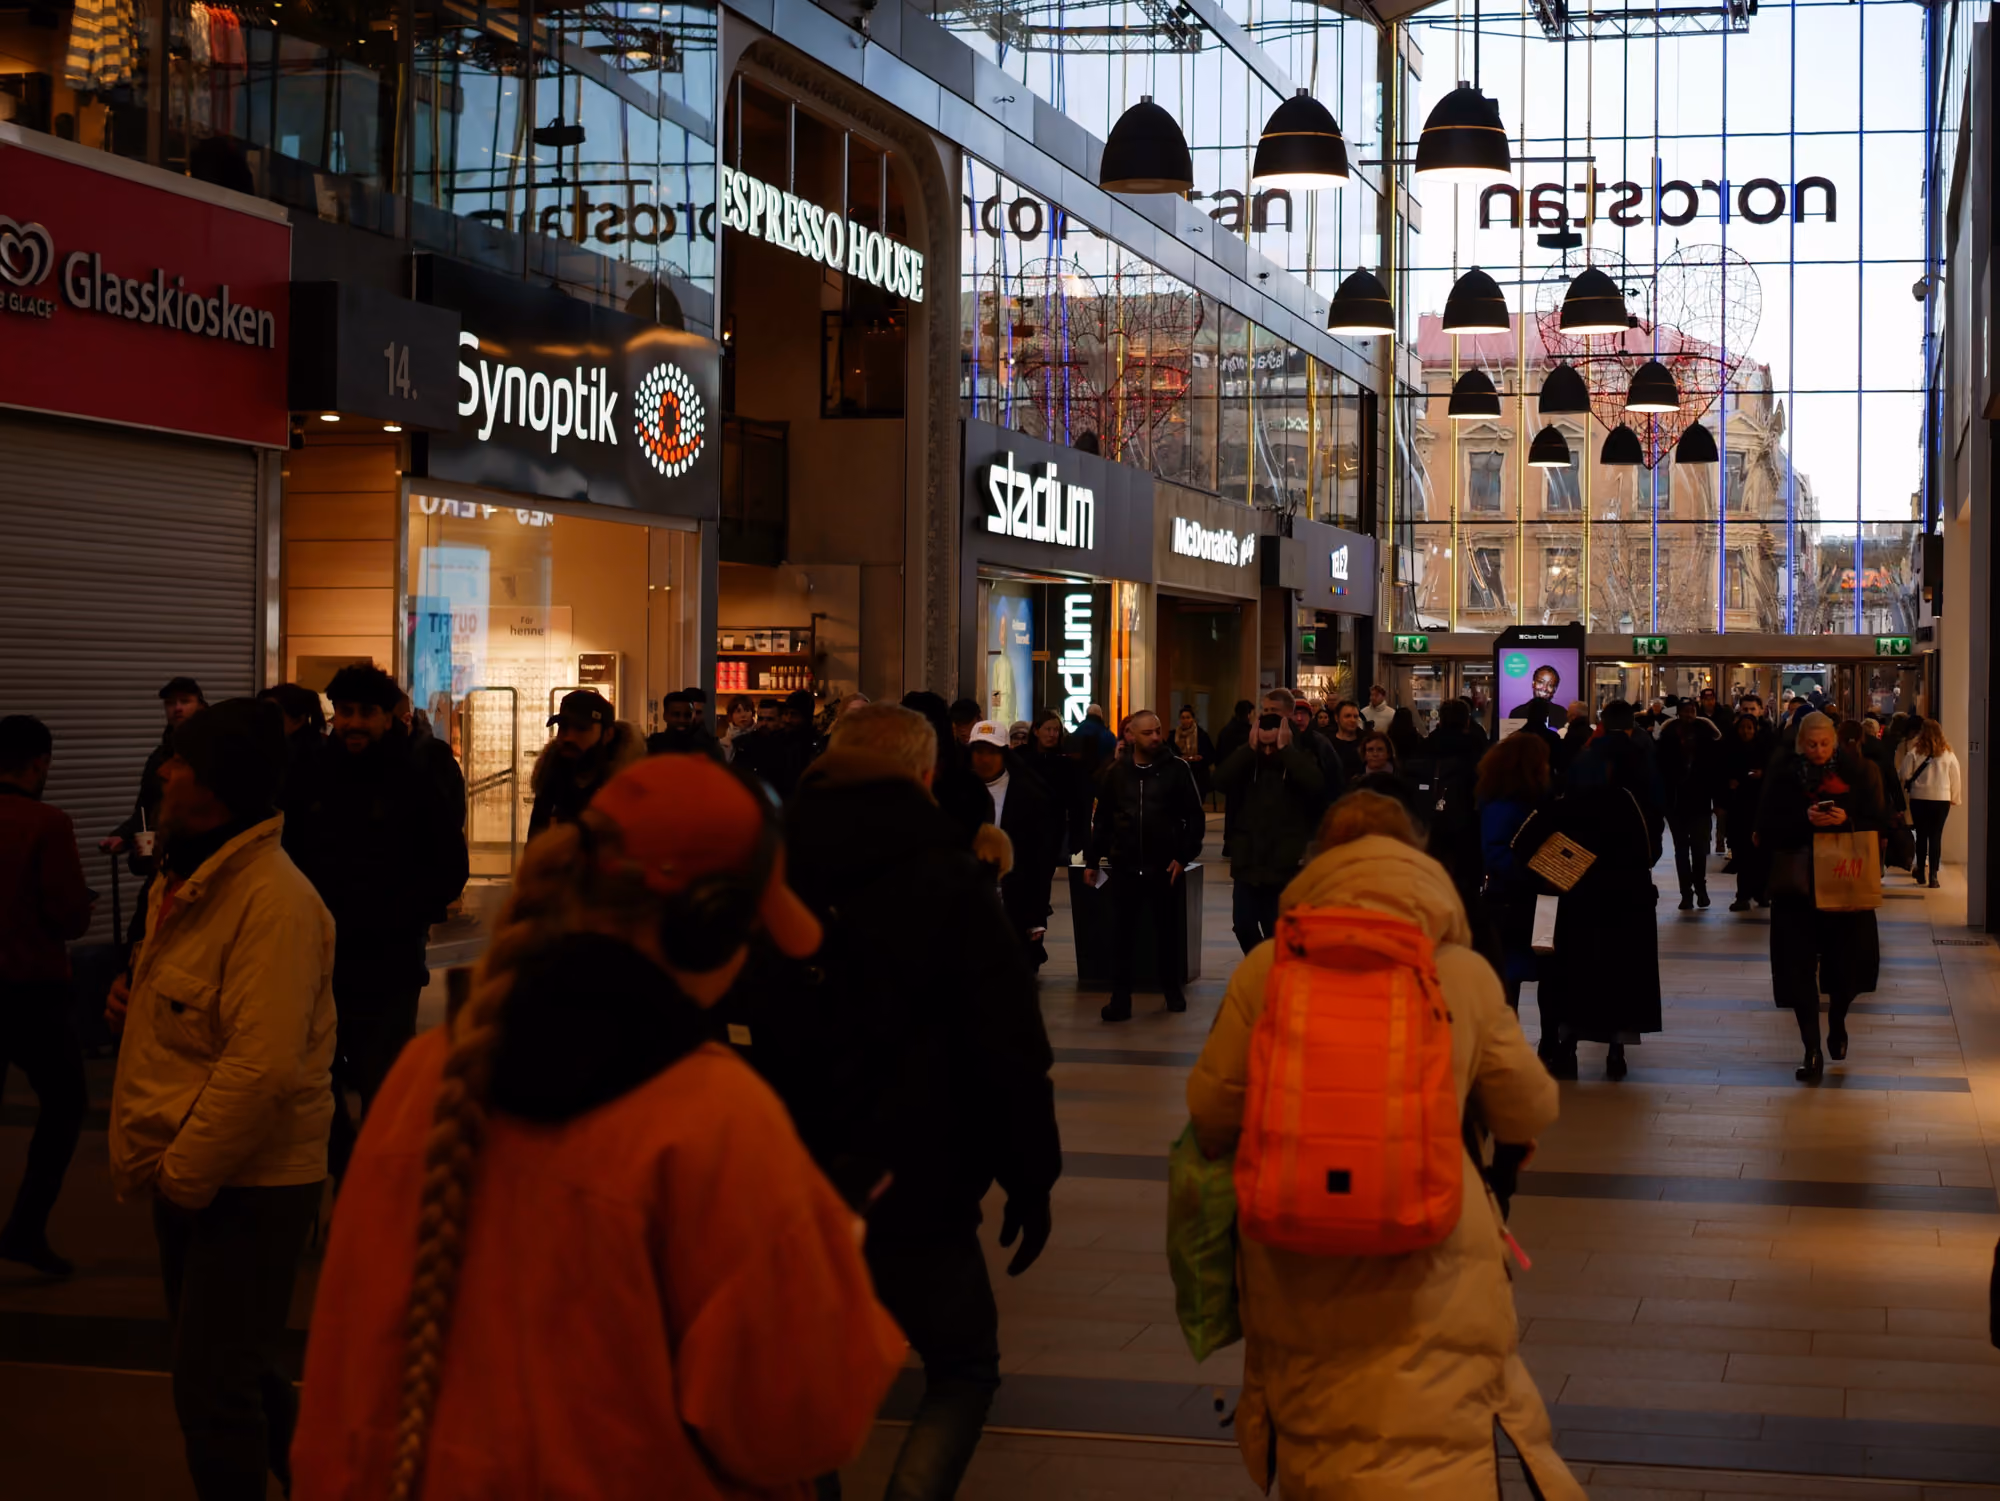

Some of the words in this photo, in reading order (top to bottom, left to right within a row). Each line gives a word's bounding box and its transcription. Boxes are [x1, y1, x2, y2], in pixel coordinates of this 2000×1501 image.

[721, 164, 845, 272] ESPRESSO
[848, 219, 925, 304] HOUSE
[9, 291, 53, 320] GLACE
[64, 250, 276, 349] Glasskiosken
[458, 330, 619, 455] Synoptik
[987, 450, 1094, 551] stadium
[1173, 516, 1239, 566] McDonald's
[510, 625, 545, 636] henne
